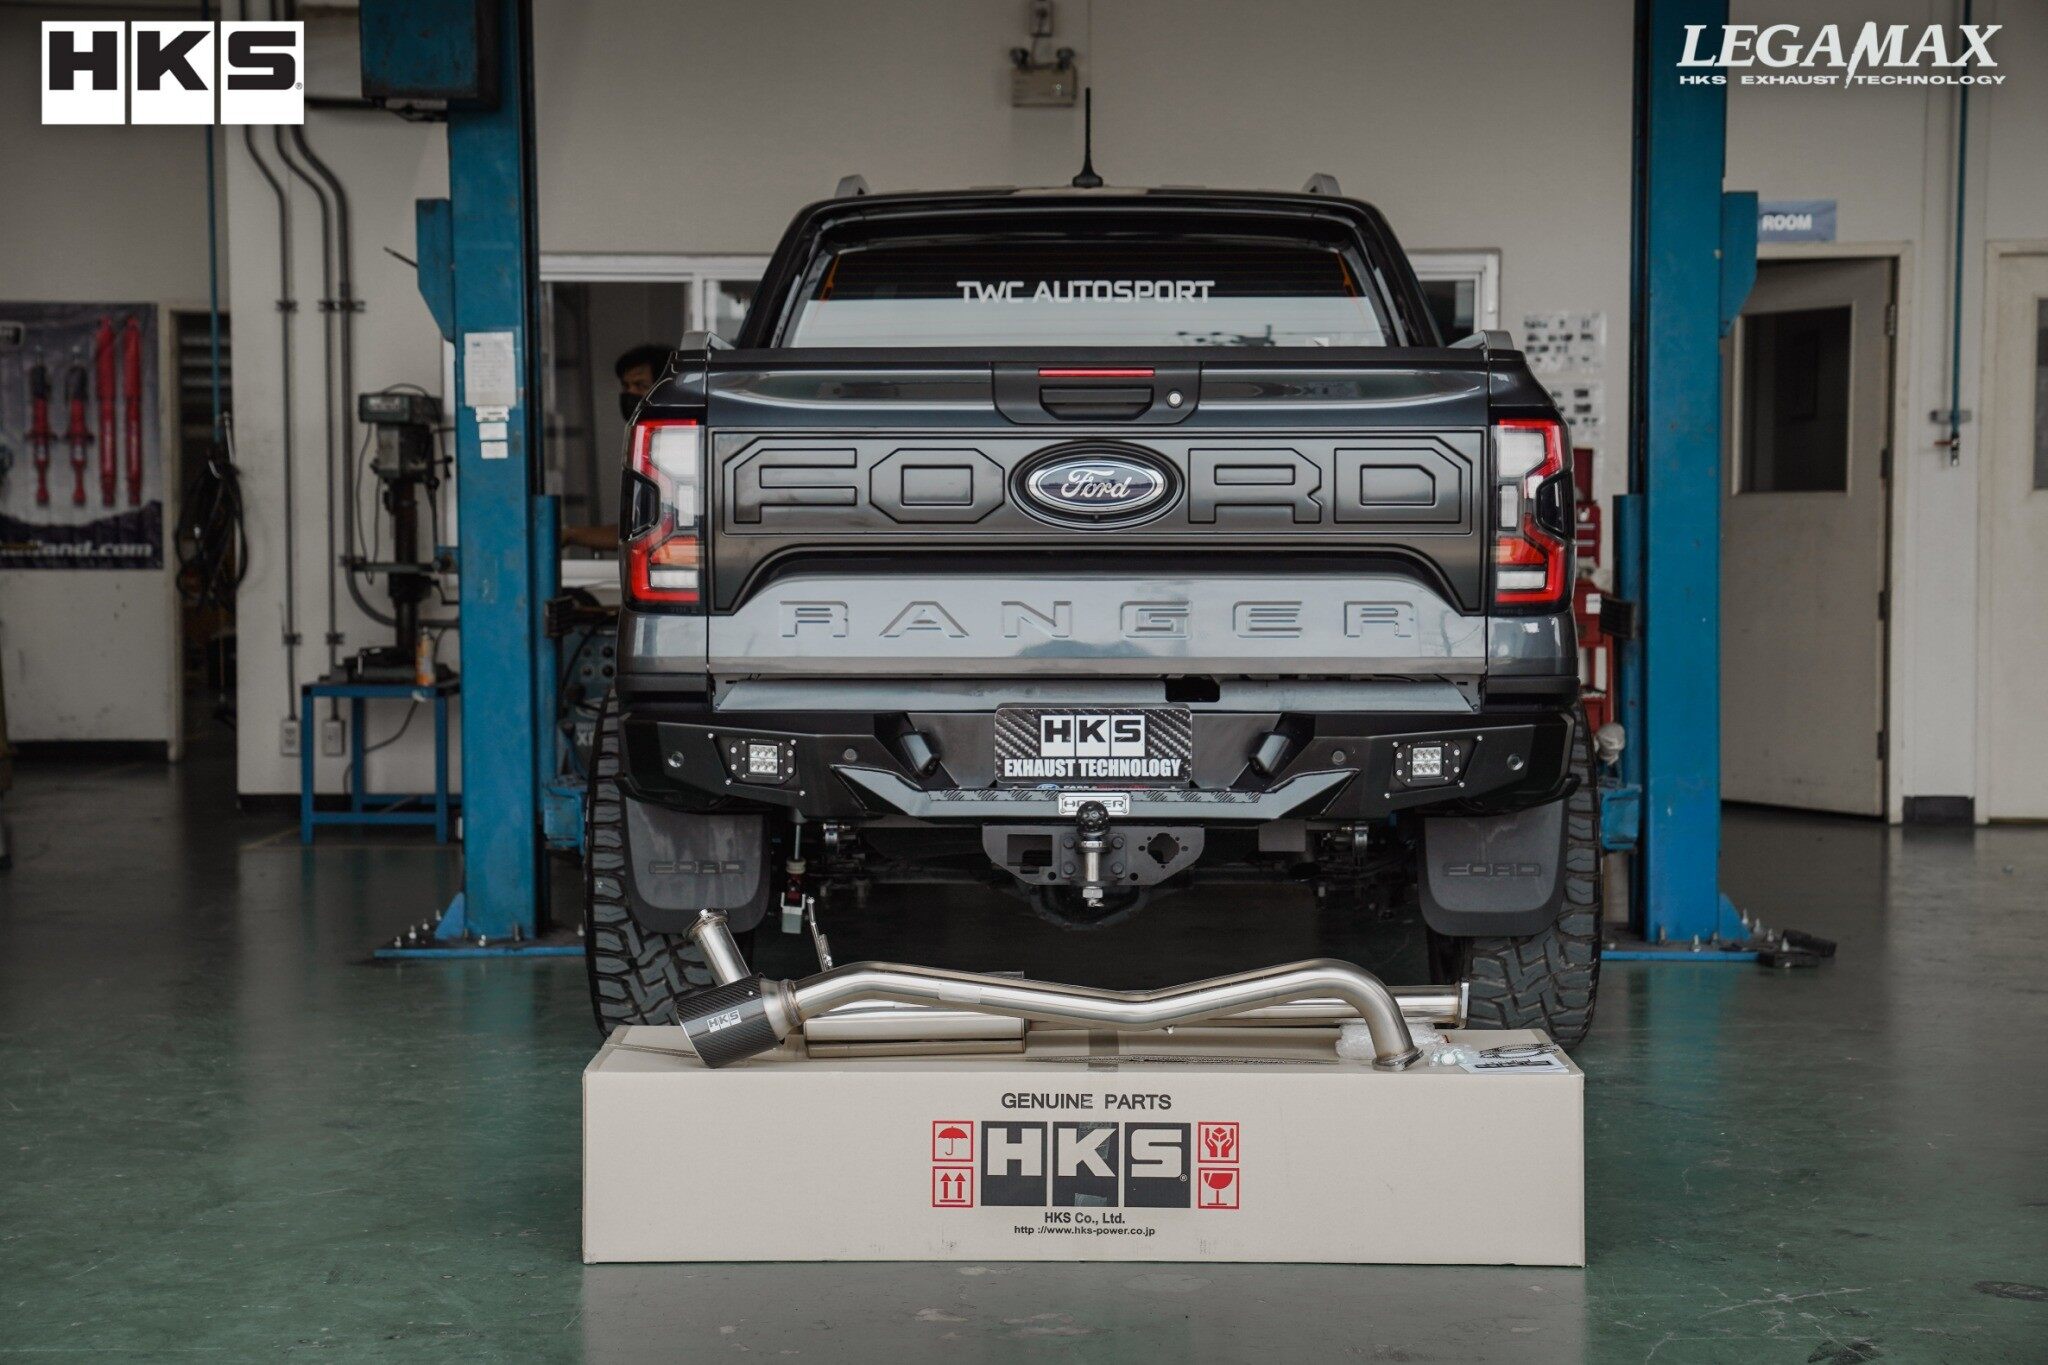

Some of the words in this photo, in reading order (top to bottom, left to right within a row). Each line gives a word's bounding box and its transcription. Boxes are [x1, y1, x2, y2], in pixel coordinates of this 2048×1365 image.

[1761, 214, 1812, 231] ROOM
[956, 280, 1024, 303] TWC
[1032, 280, 1215, 303] AUTOSPORT
[1060, 467, 1132, 499] Ford
[779, 600, 1418, 639] RANGER
[1043, 718, 1142, 743] HKS
[1004, 758, 1076, 777] EXHAUST
[1079, 758, 1182, 777] TECHNOLOGY
[707, 1010, 741, 1030] HKS
[1001, 1092, 1094, 1110] GENUINE
[1104, 1093, 1172, 1110] PARTS
[987, 1126, 1184, 1179] HKS
[1044, 1212, 1072, 1224] HKS
[1075, 1212, 1099, 1227] Co.,
[1102, 1212, 1126, 1225] Ltd.
